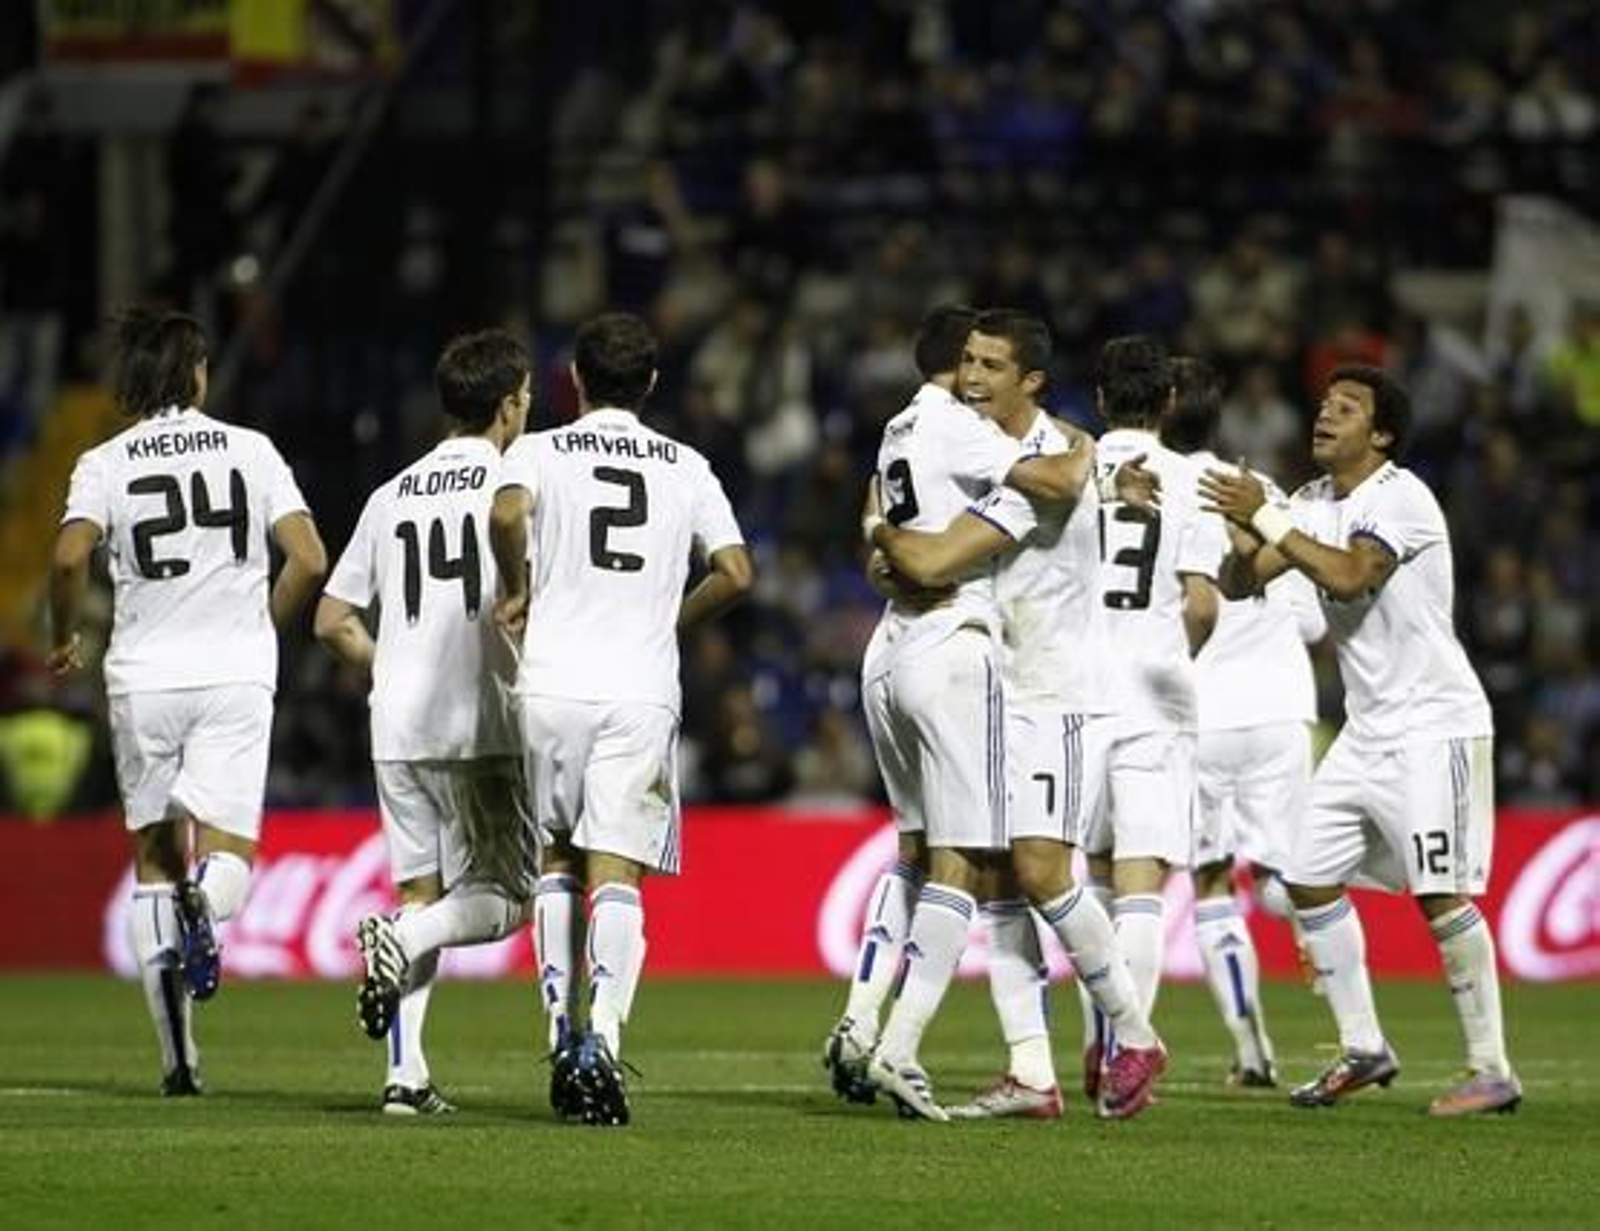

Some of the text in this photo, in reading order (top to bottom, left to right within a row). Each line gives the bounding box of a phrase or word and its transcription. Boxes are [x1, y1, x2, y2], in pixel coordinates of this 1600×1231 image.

[126, 430, 228, 460] KHEDIRA
[552, 431, 678, 464] CARVALHO
[397, 465, 487, 498] ALONSO
[127, 467, 249, 579] 24
[589, 466, 648, 571] 2
[395, 512, 481, 628] 14
[1032, 773, 1055, 815] 7
[1412, 830, 1450, 874] 12
